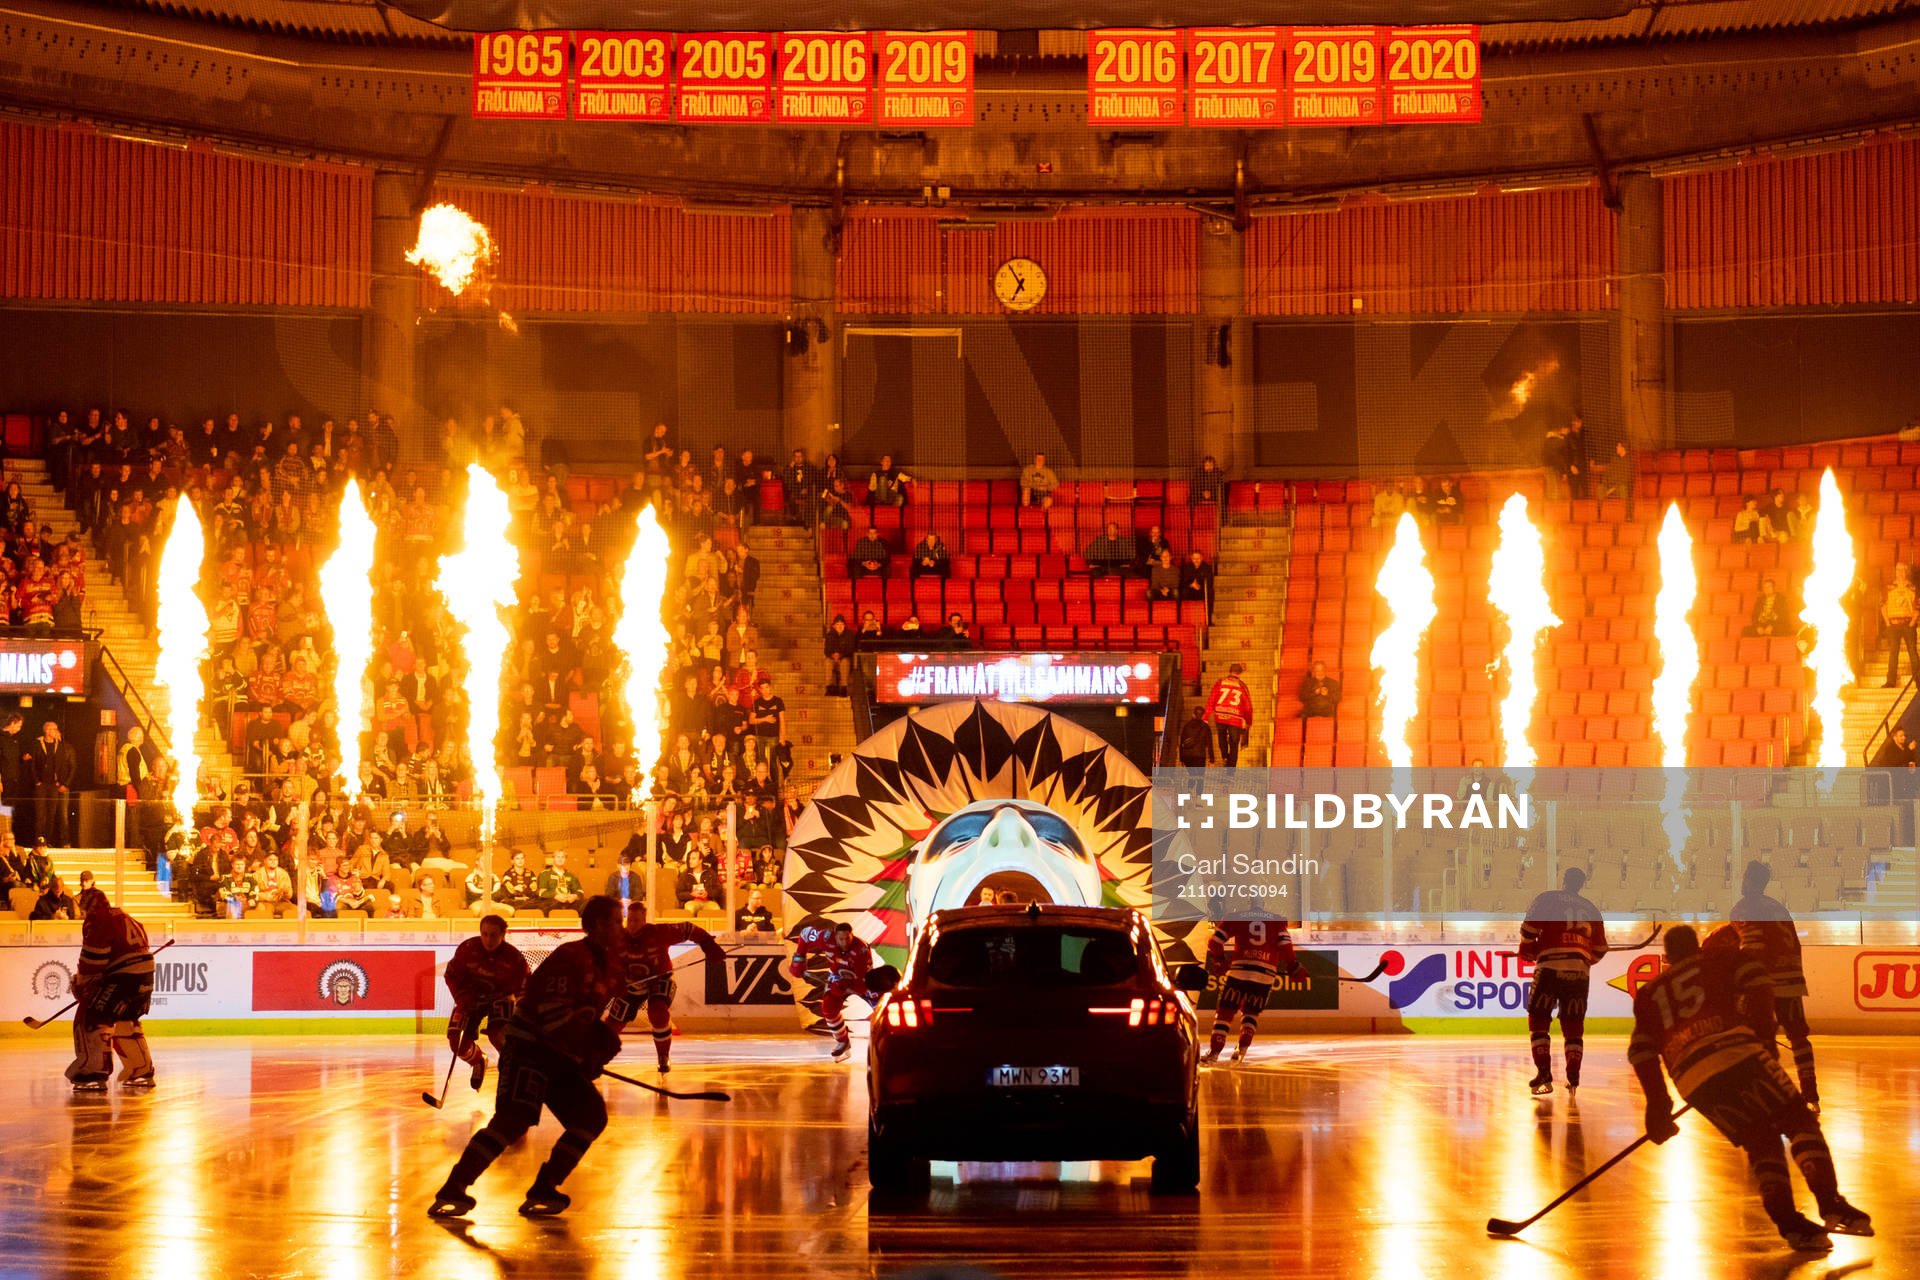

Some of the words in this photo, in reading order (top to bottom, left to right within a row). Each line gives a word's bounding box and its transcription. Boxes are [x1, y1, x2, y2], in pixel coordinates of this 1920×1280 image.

[479, 35, 563, 78] 1965
[581, 38, 665, 78] 2003
[682, 40, 766, 80] 2005
[783, 39, 866, 82] 2016
[885, 40, 967, 84] 2019
[1094, 40, 1176, 83] 2016
[1195, 41, 1276, 84] 2017
[1293, 40, 1375, 83] 2019
[1389, 38, 1476, 80] 2020
[477, 89, 544, 114] FRÖLUNDA
[580, 90, 646, 115] FRÖLUNDA
[681, 91, 748, 117] FRÖLUNDA
[782, 92, 849, 118] FRÖLUNDA
[885, 92, 950, 118] FRÖLUNDA
[1094, 95, 1160, 118] FRÖLUNDA
[1195, 96, 1260, 119] FRÖLUNDA
[1293, 94, 1359, 118] FRÖLUNDA
[1393, 89, 1457, 114] FRÖLUNDA
[1217, 687, 1242, 706] 73
[1248, 920, 1267, 946] 9
[155, 962, 208, 992] MPUS
[1456, 950, 1537, 979] INTE
[1454, 980, 1536, 1010] SPO
[1651, 967, 1705, 1030] 15
[1000, 1069, 1033, 1084] MWN
[1038, 1069, 1073, 1084] 93M
